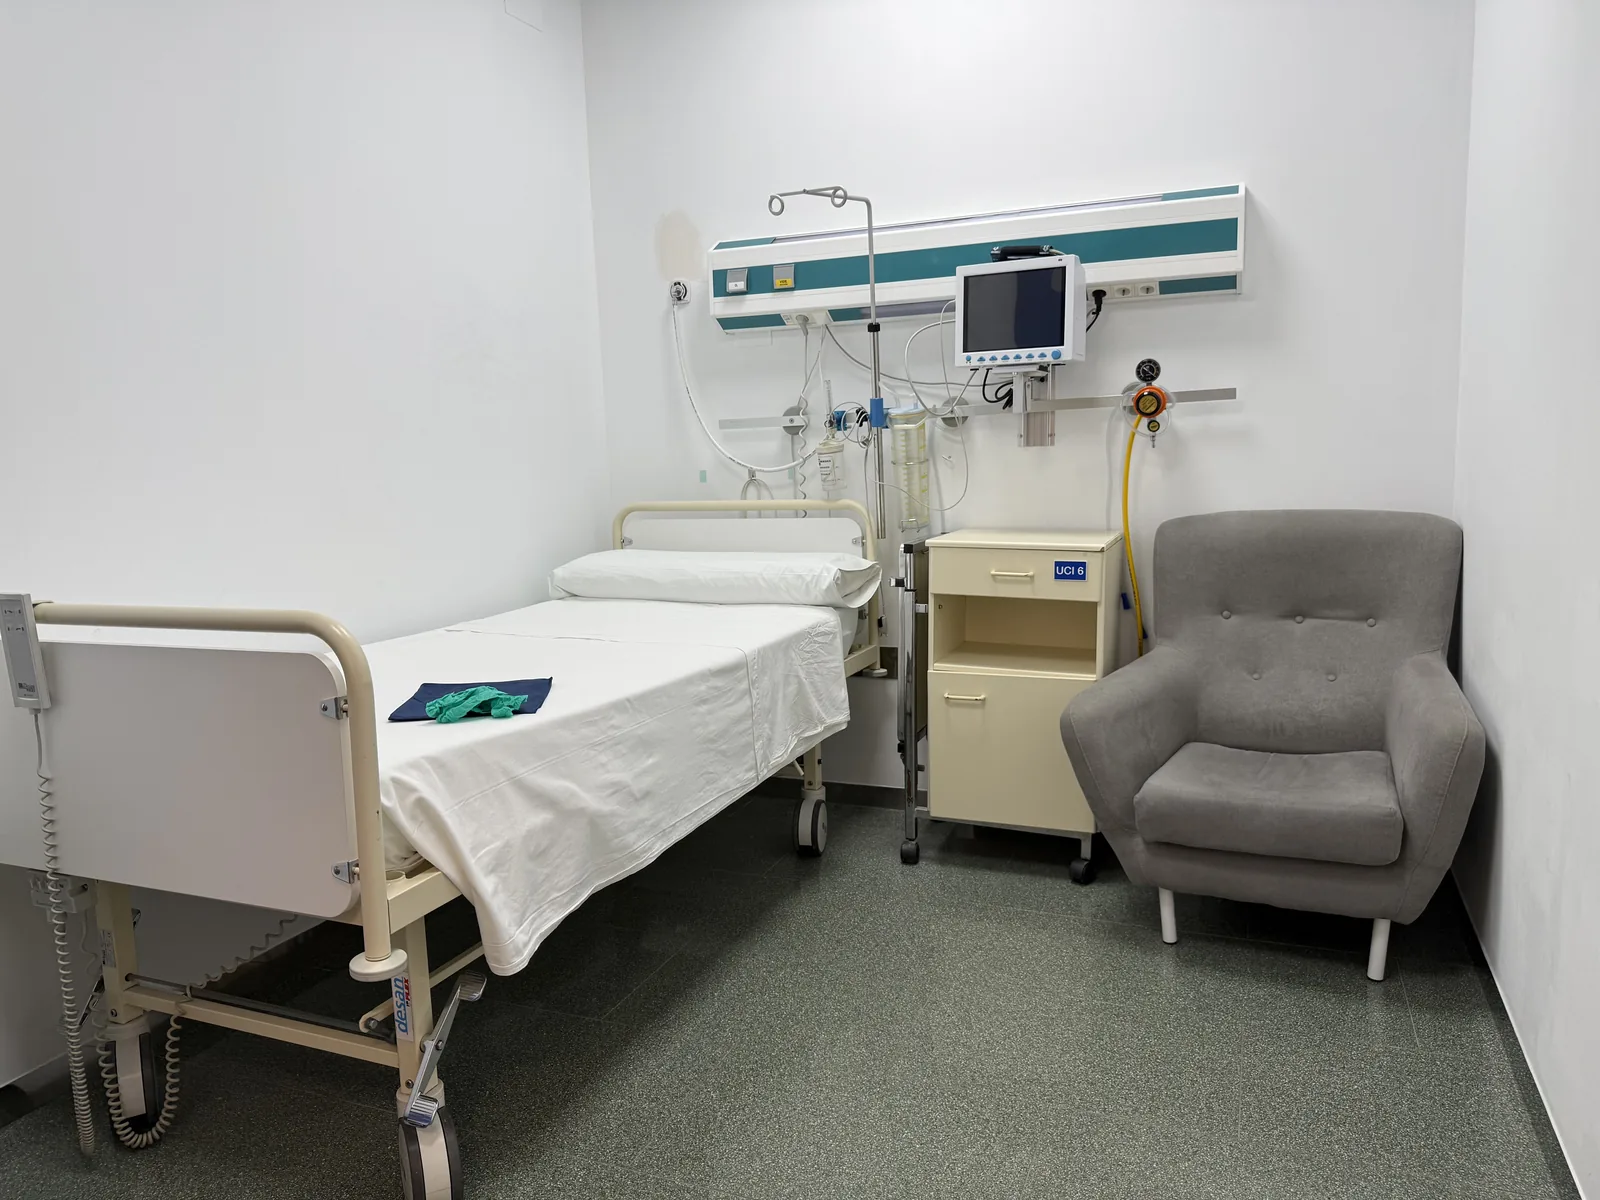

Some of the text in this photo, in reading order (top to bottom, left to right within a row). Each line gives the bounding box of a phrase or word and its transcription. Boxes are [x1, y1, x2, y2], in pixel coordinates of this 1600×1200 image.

[1056, 566, 1084, 575] UCI 6
[394, 977, 408, 1034] desan
